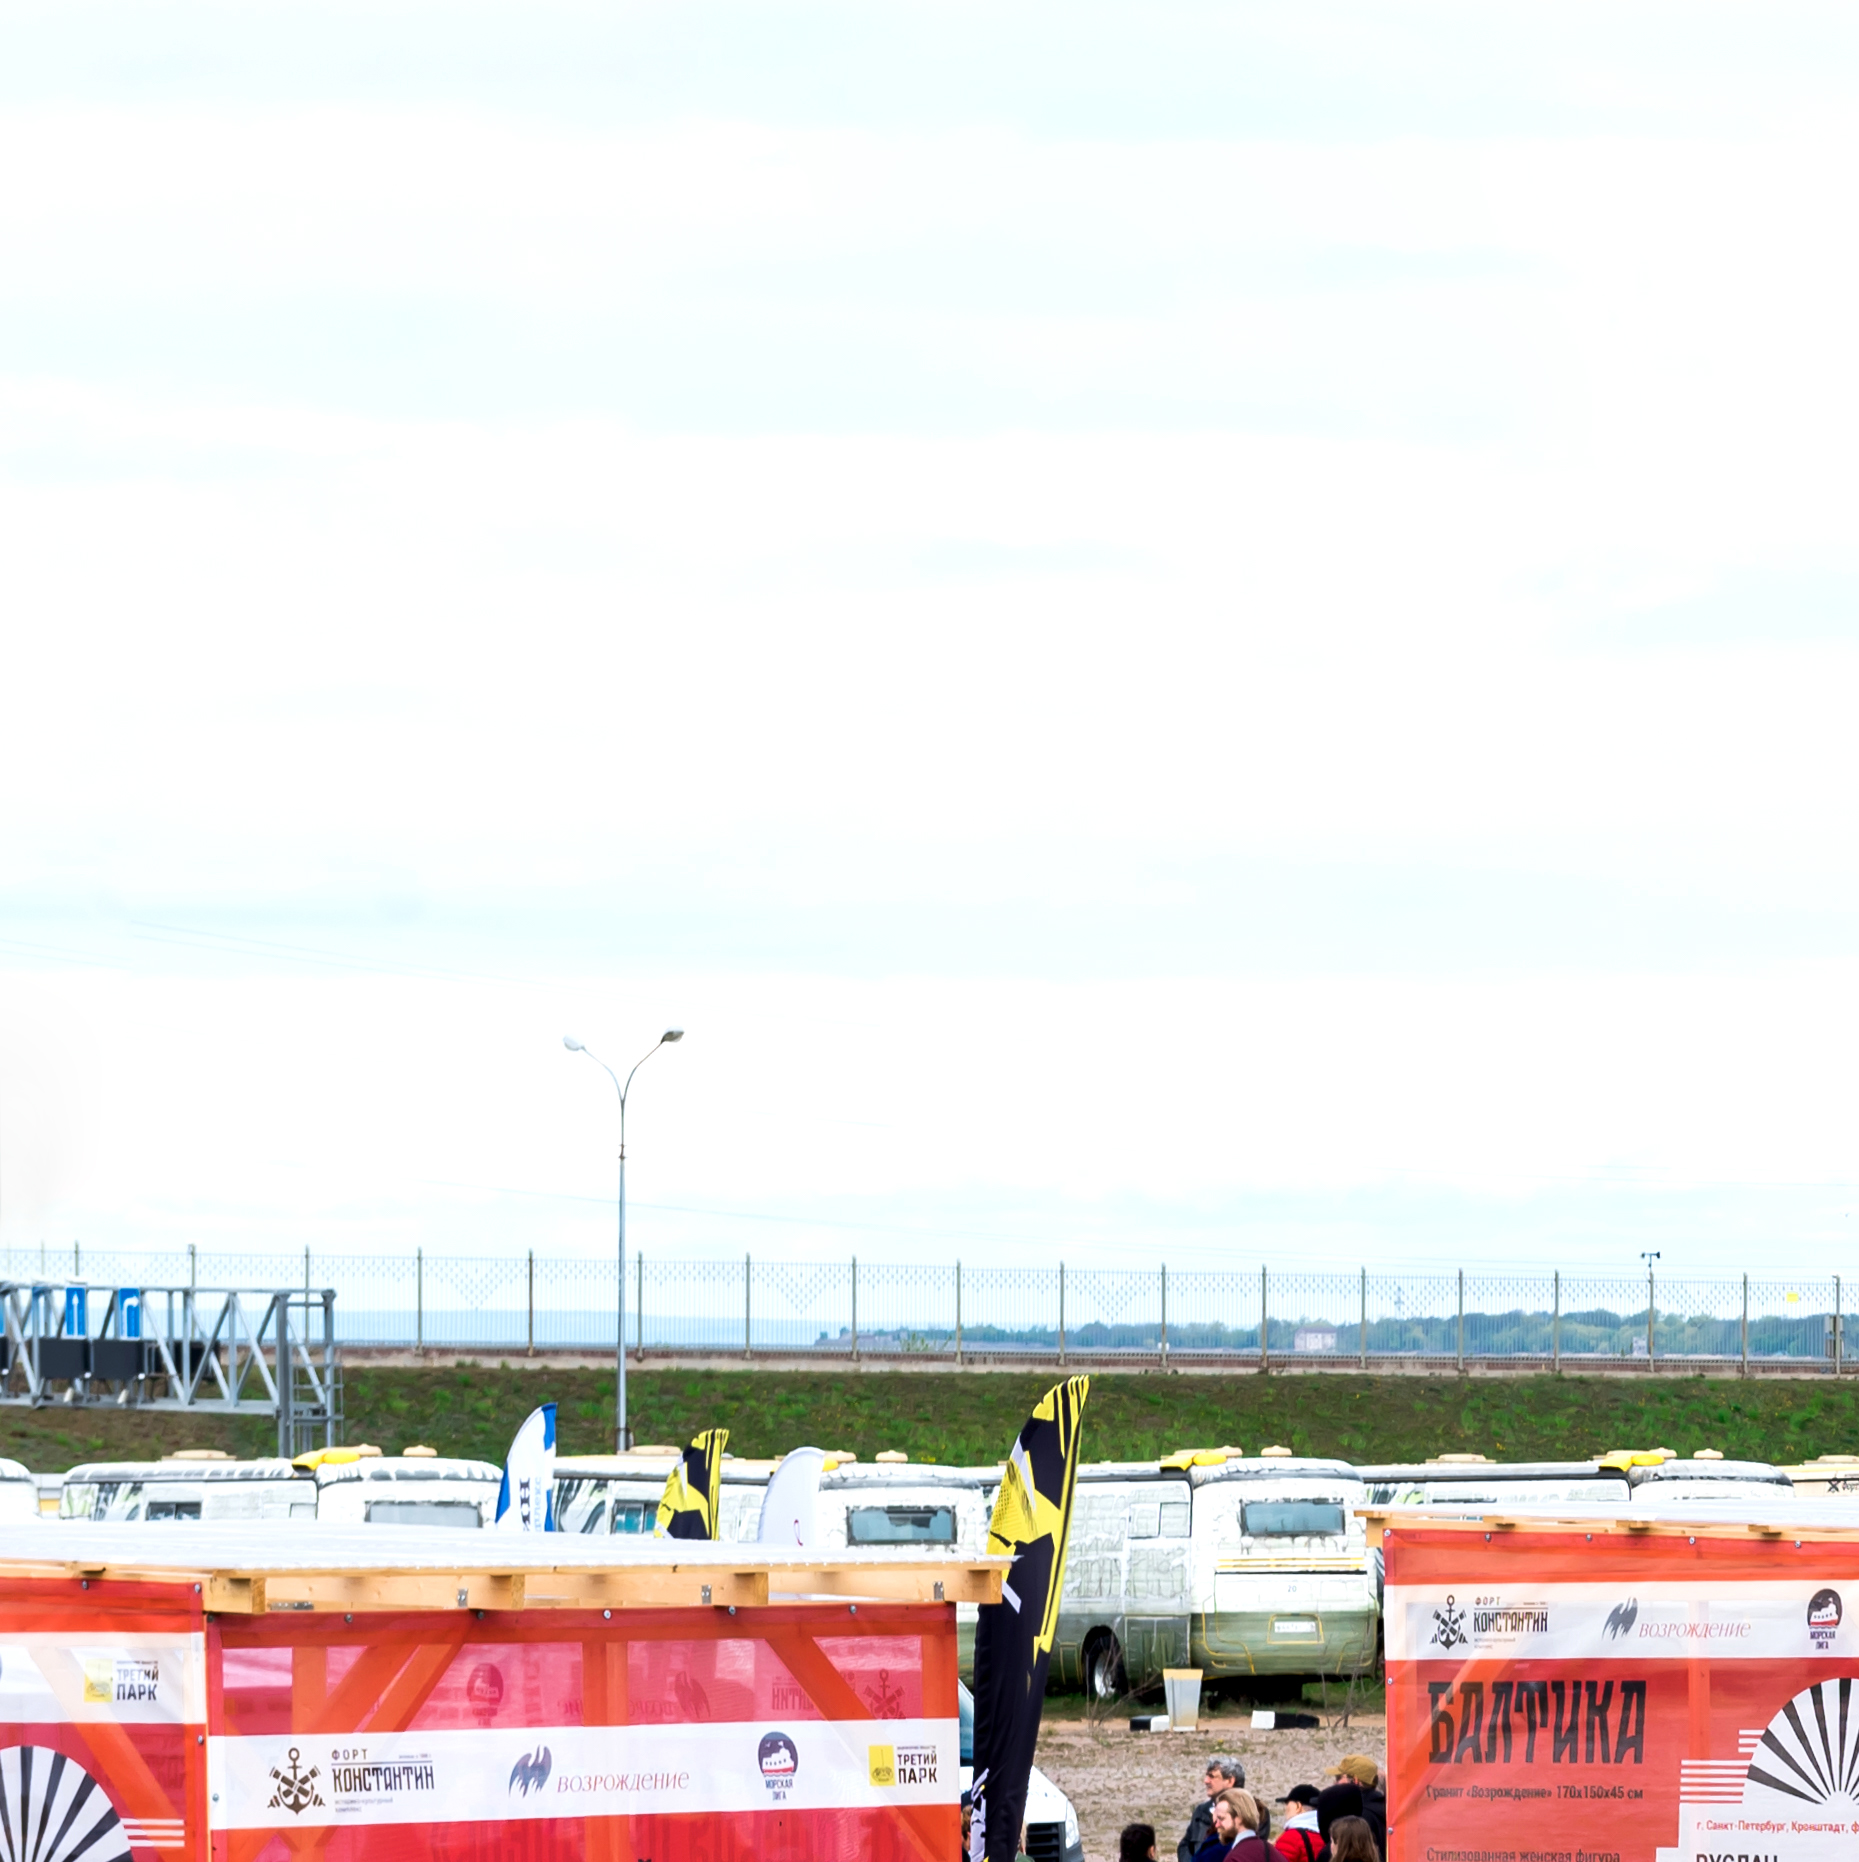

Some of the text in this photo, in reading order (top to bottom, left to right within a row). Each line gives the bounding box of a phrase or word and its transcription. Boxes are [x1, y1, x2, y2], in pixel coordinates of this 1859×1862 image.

[1473, 1611, 1548, 1633] КОНСТАНТИН
[117, 1665, 159, 1681] ТРЕТИЙ
[116, 1684, 157, 1700] ПАРК
[1427, 1680, 1647, 1765] БАЛТИКА
[331, 1749, 368, 1761] ФОРТ
[898, 1751, 937, 1765] ТРЕТИЙ
[332, 1765, 434, 1793] КОНСТАНТИН
[898, 1768, 937, 1784] ПАРК
[1706, 1819, 1789, 1834] Санкт-Петербург,
[1427, 1848, 1516, 1862] Стилизованная
[1520, 1851, 1572, 1862] женская
